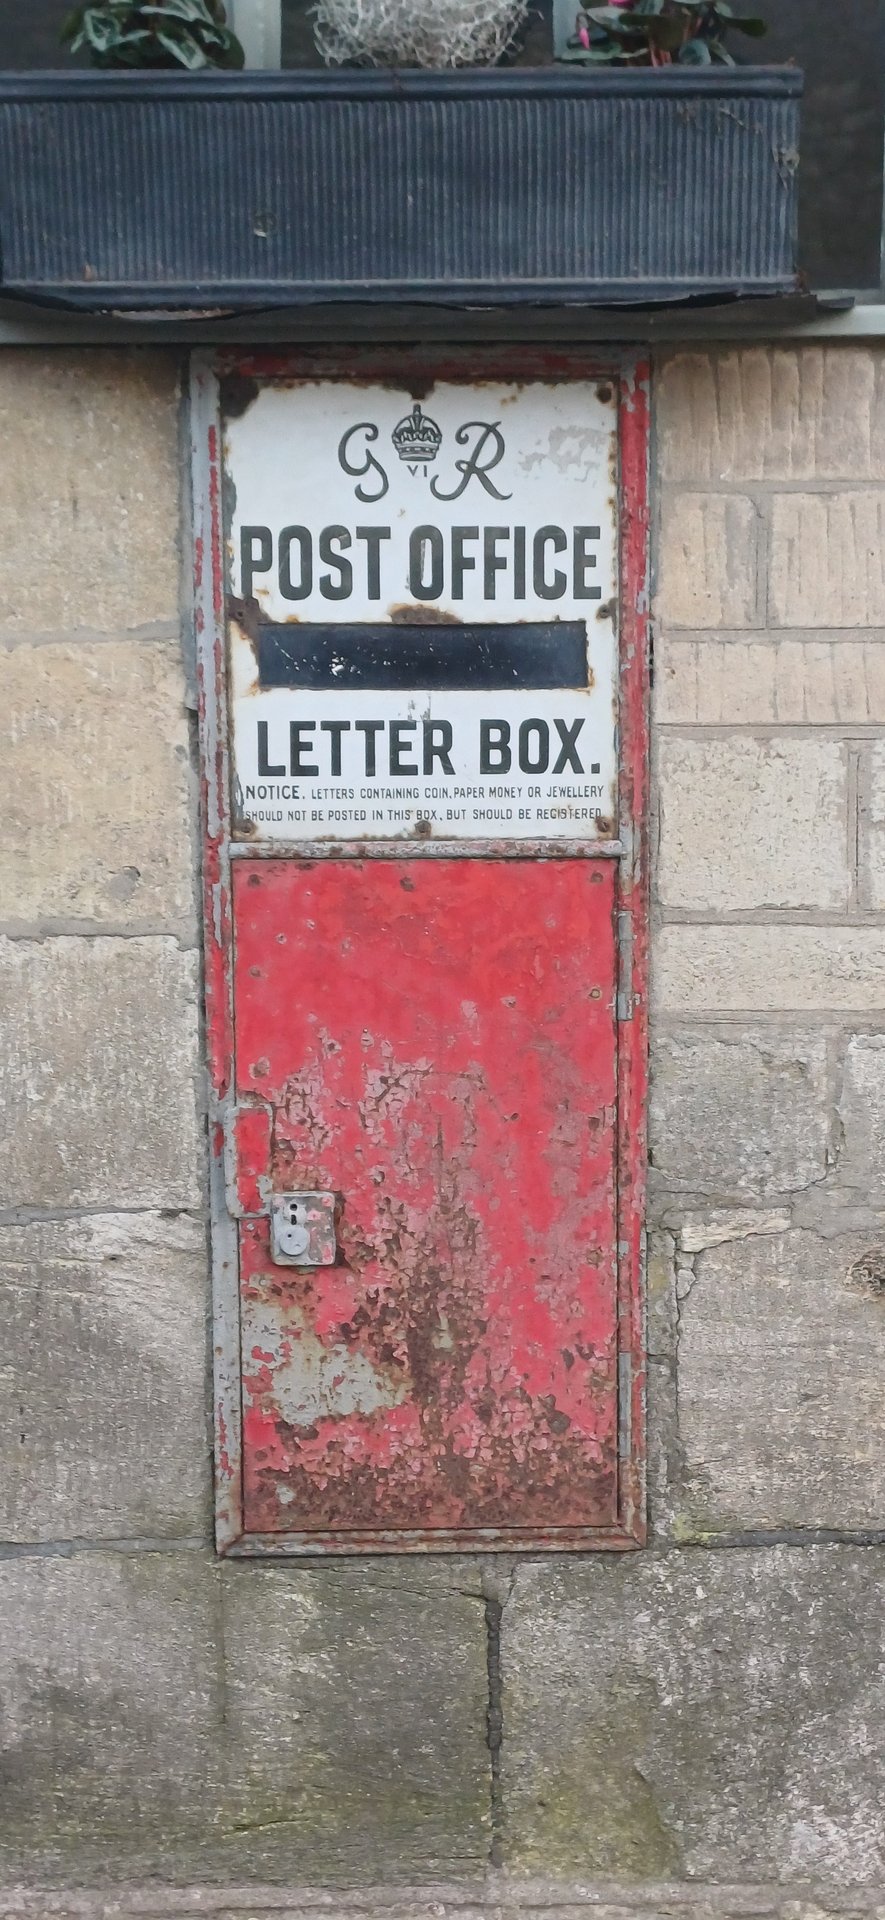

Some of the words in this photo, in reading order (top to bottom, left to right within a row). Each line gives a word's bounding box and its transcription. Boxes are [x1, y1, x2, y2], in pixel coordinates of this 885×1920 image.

[407, 465, 428, 477] VI
[240, 525, 391, 601] POST
[409, 525, 602, 601] OFFICE
[257, 720, 456, 777] LETTER
[480, 718, 600, 774] BOX.
[246, 785, 305, 800] NOTICE.
[312, 788, 355, 799] LETTERS
[360, 787, 419, 799] CONTAINING
[454, 787, 484, 798] PAPER
[489, 787, 522, 798] MONEY
[528, 786, 541, 797] OR
[547, 785, 604, 797] JEWELLERY
[246, 811, 282, 821] SHOULD
[288, 811, 306, 821] NOT
[312, 810, 324, 821] BE
[328, 810, 366, 821] POSTED
[373, 810, 383, 820] IN
[387, 810, 411, 820] THIS
[446, 809, 466, 820] BUT
[473, 809, 512, 819] SHOULD
[519, 808, 531, 819] BE
[537, 808, 601, 819] REGISTERED
